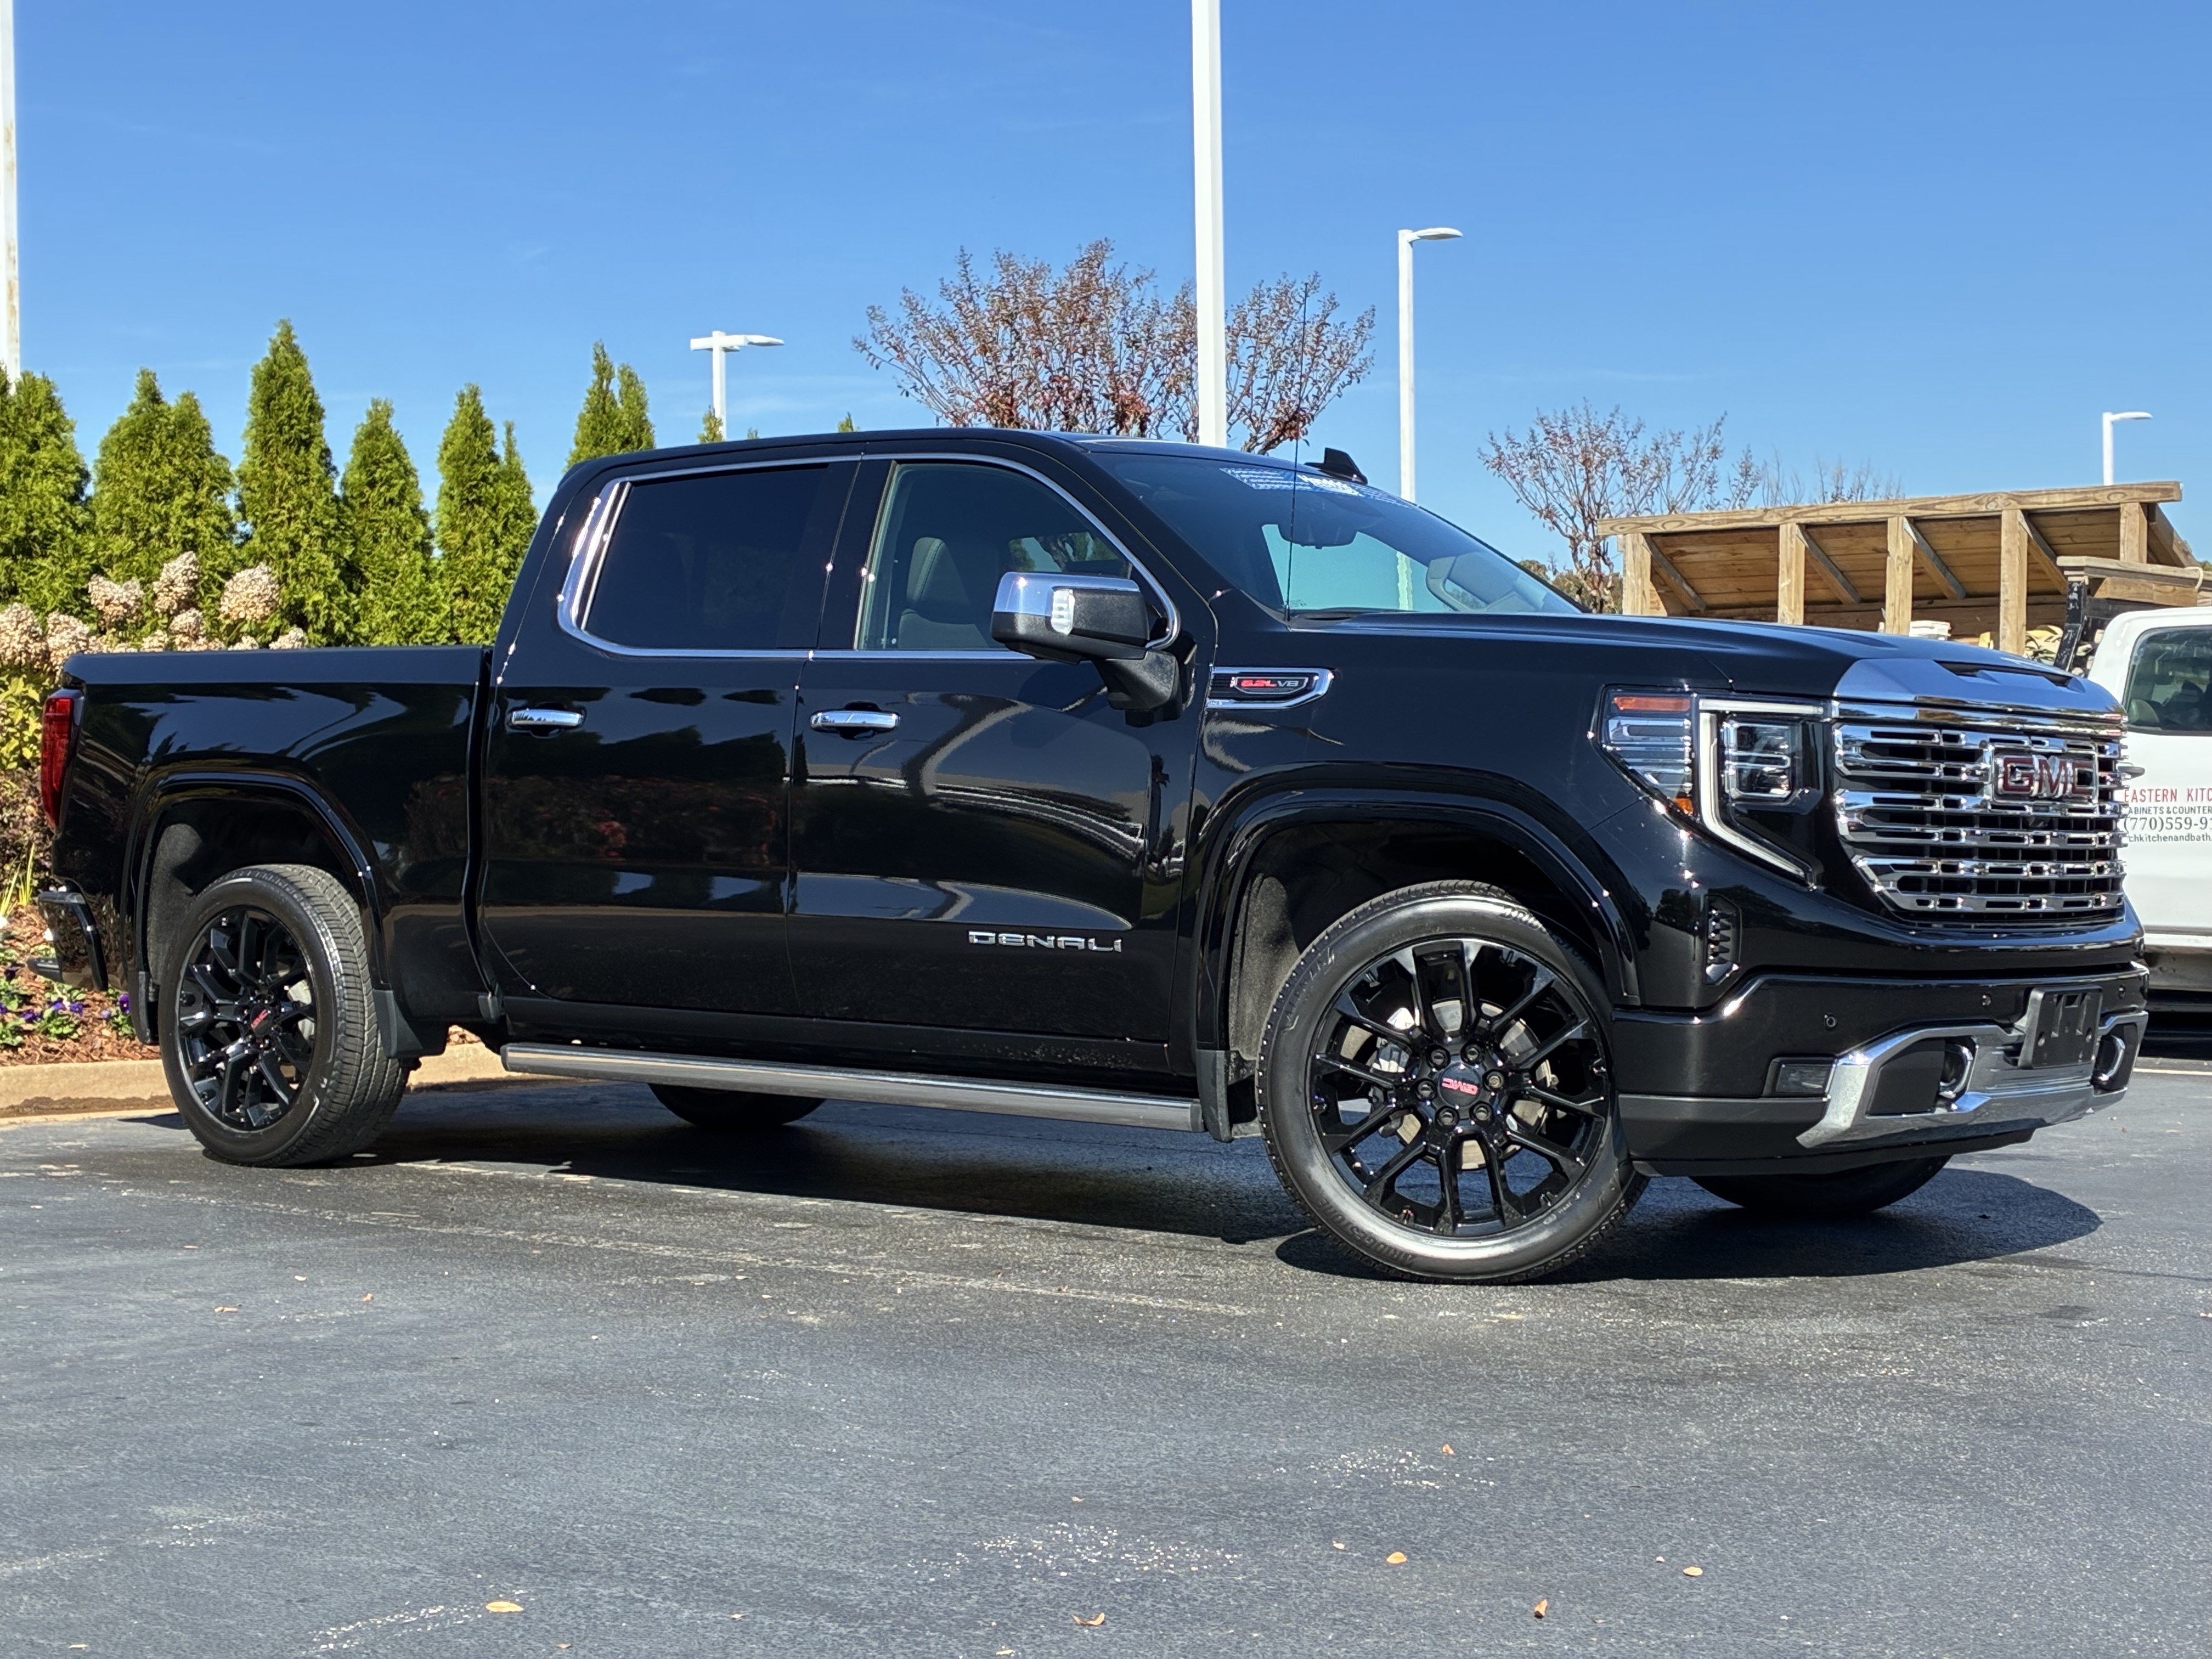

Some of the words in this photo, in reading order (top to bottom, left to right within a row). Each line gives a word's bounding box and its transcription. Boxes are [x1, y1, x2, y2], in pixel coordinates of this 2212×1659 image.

[1998, 754, 2095, 798] GMC
[2124, 788, 2177, 803] EASTERN
[2129, 806, 2164, 815] ABINETS
[968, 931, 1122, 953] DENALI
[1442, 1077, 1479, 1096] GMC
